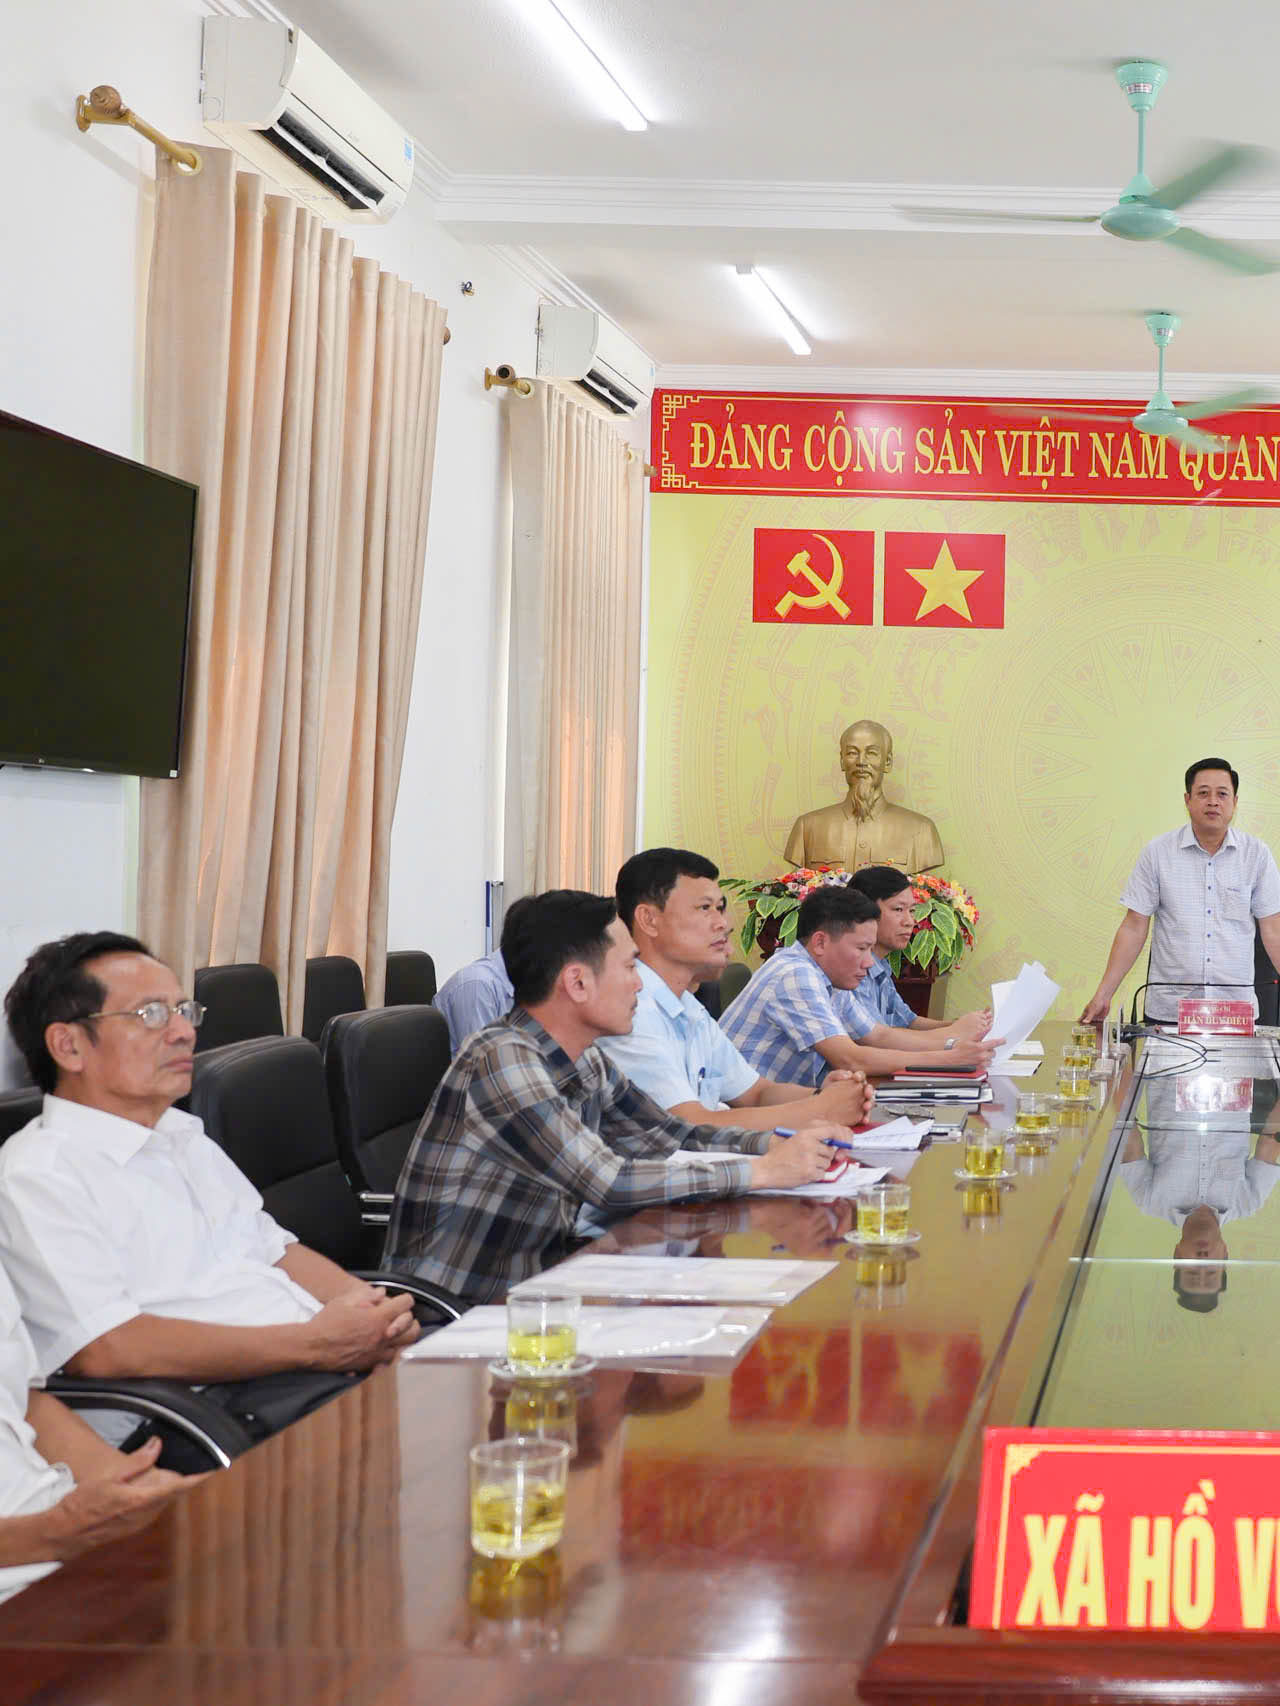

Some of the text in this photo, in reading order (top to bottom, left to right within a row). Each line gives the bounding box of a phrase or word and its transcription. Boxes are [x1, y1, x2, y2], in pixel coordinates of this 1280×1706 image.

[690, 403, 793, 471] ĐẢNG
[804, 410, 906, 486] CỘNG
[914, 408, 987, 475] SẢN
[995, 416, 1080, 490] VIỆT
[1088, 430, 1169, 480] NAM
[1015, 1492, 1108, 1627] XÃ
[1126, 1479, 1216, 1631] HỒ
